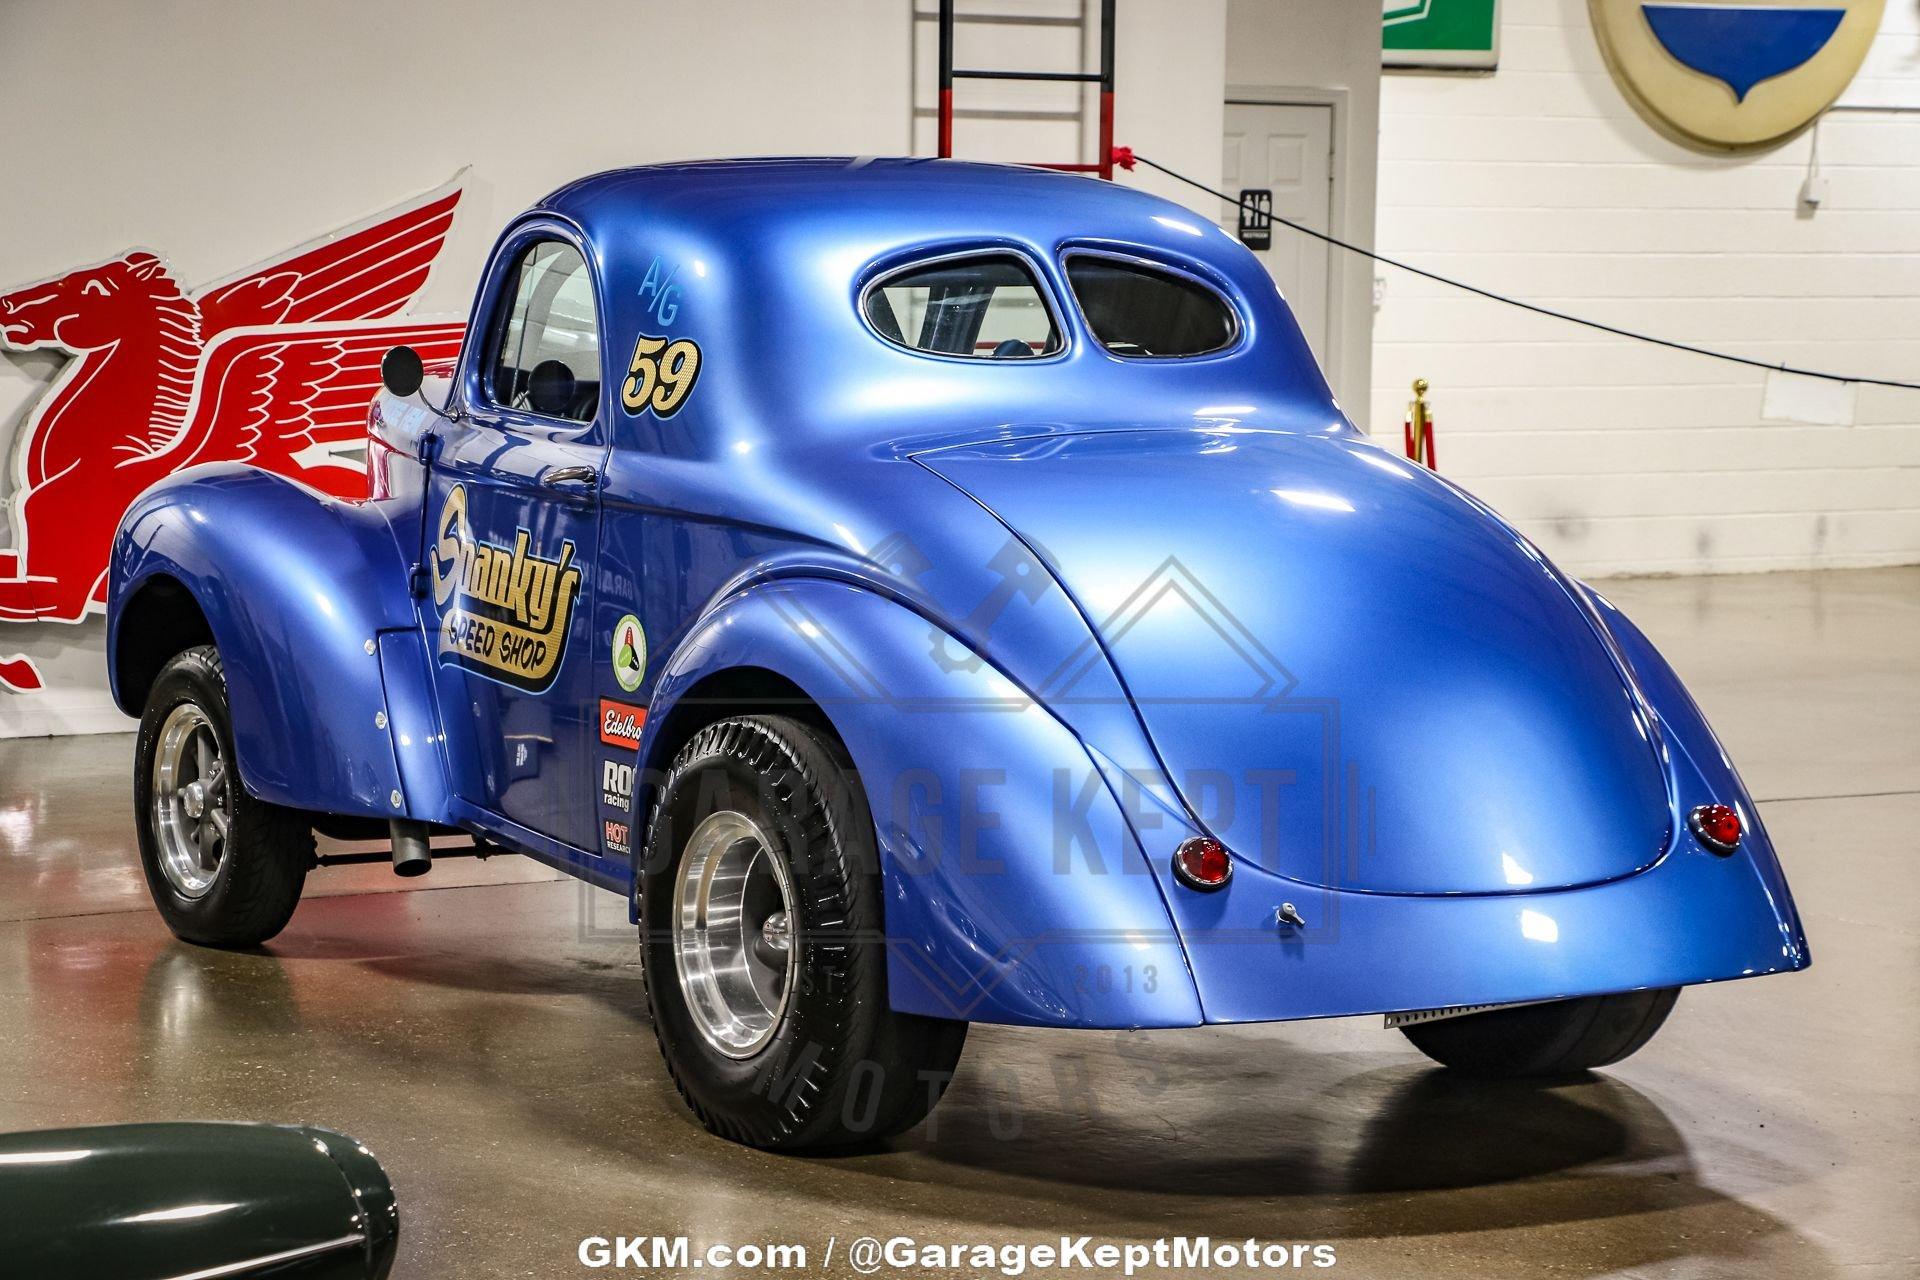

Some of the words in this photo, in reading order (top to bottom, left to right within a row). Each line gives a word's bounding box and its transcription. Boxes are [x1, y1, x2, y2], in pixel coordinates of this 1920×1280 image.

[638, 255, 683, 327] A/G
[620, 332, 703, 420] 59
[448, 613, 495, 657] SPEED
[499, 631, 547, 671] SHOP
[604, 709, 642, 740] Edelbro
[604, 793, 630, 812] racing
[605, 821, 629, 845] HOT
